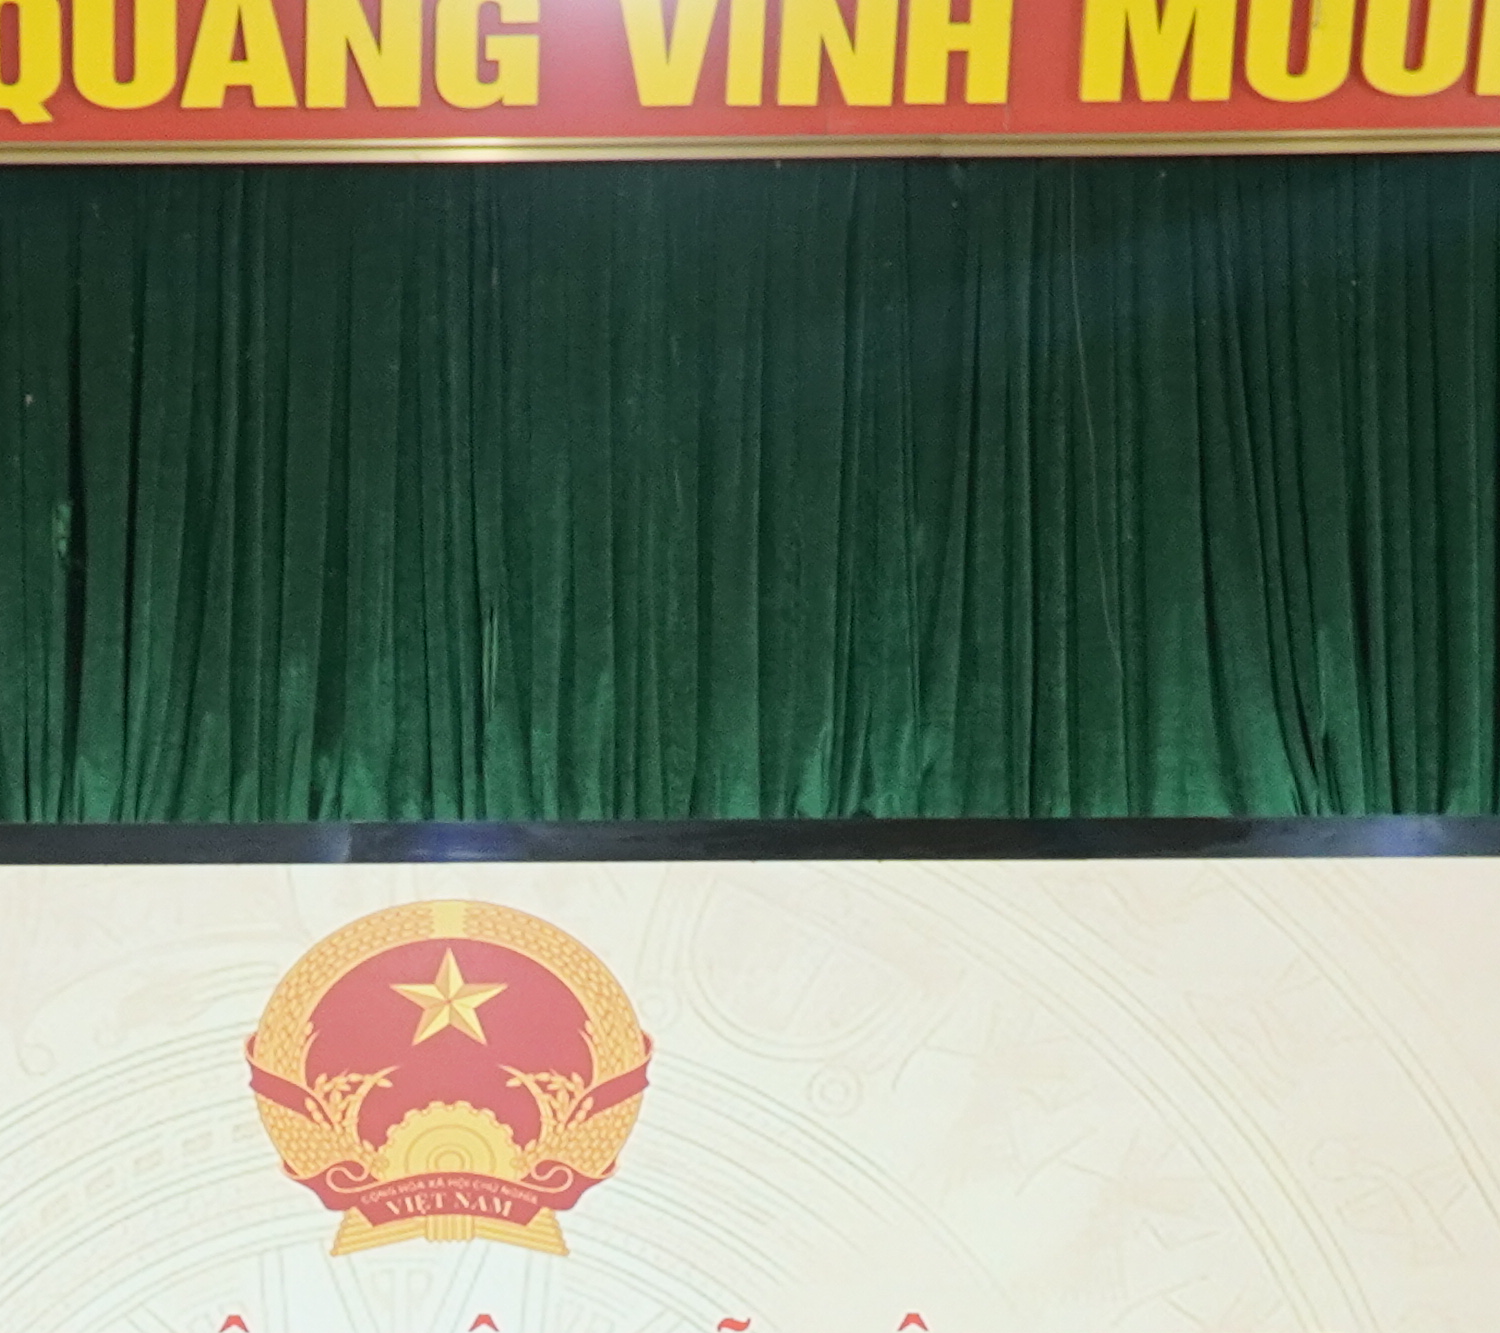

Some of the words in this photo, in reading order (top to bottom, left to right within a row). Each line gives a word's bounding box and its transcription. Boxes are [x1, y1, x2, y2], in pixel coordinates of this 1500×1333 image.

[620, 0, 1012, 107] VINH
[385, 1191, 447, 1215] VIỆT
[454, 1191, 512, 1217] NAM
